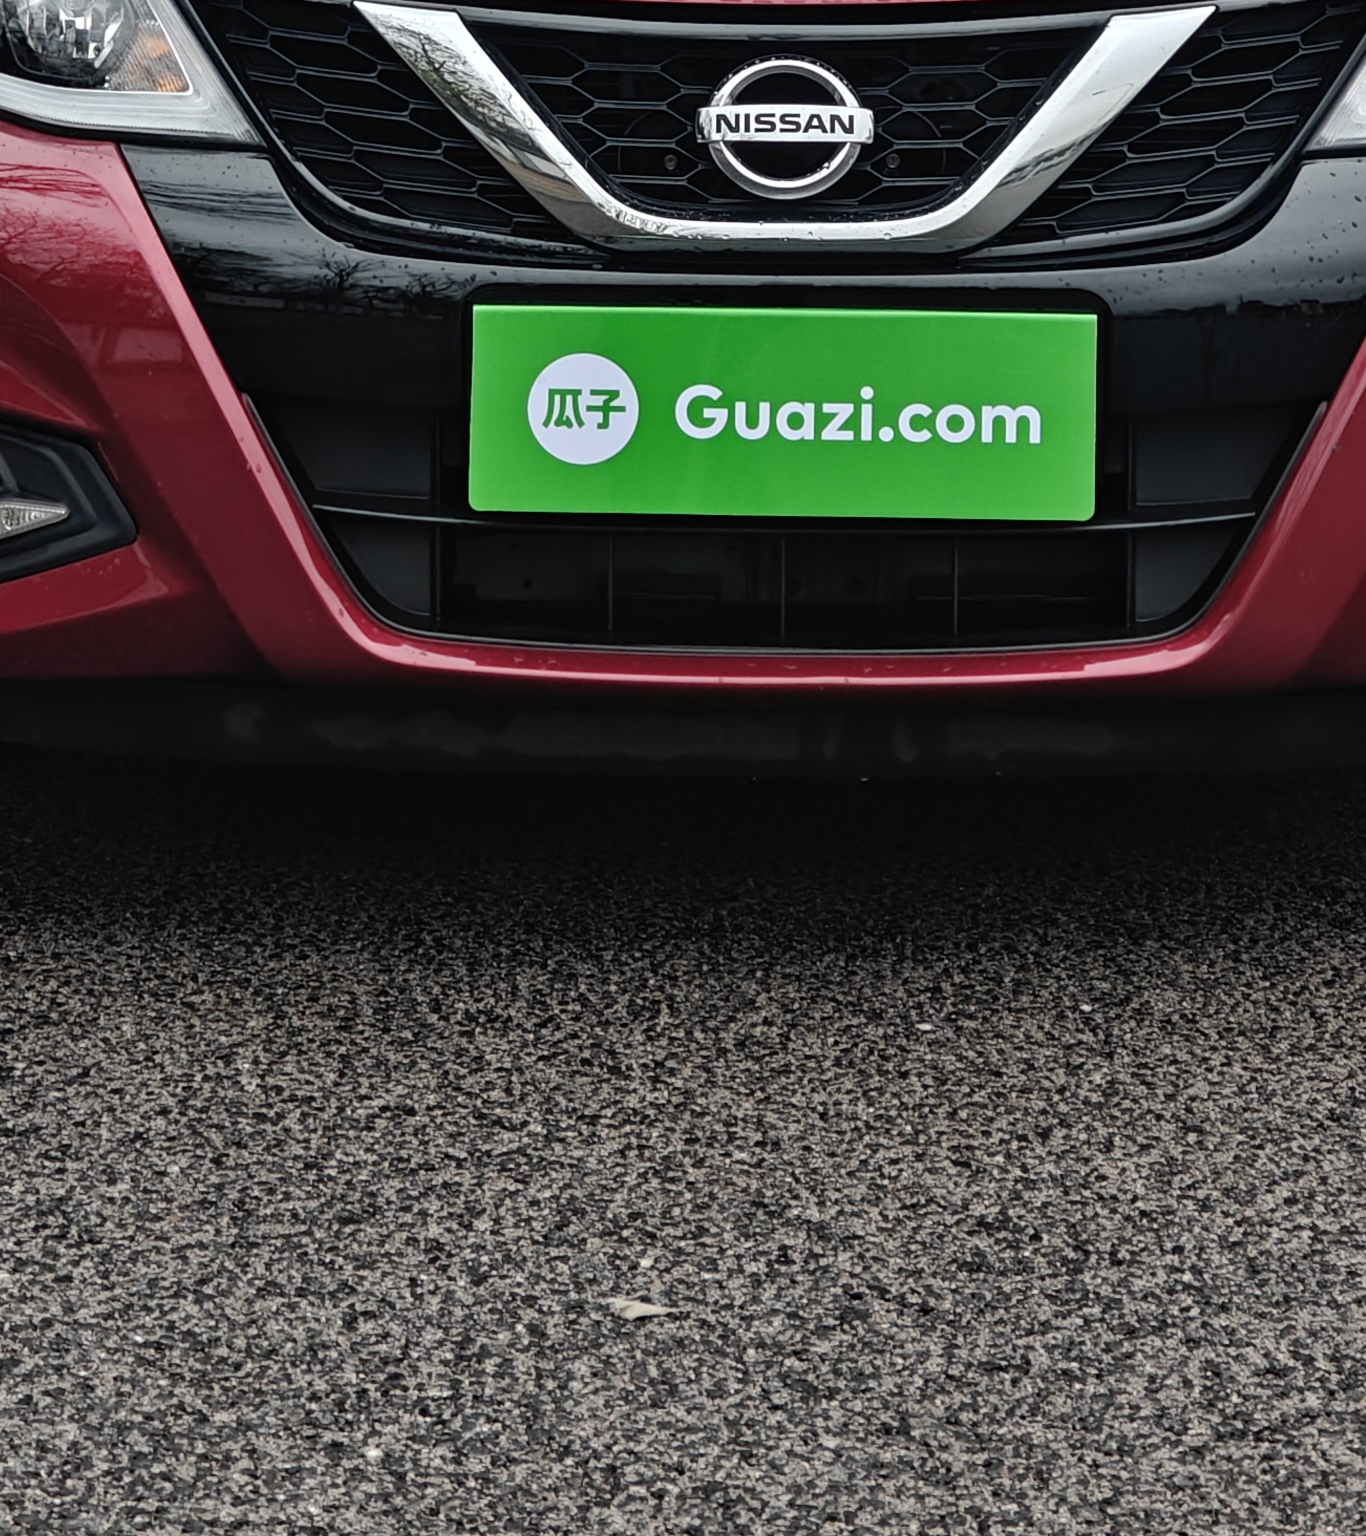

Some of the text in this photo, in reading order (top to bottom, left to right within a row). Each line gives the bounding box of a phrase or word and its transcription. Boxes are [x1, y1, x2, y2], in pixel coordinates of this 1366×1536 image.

[715, 113, 855, 135] NISSAN
[541, 388, 627, 431] 瓜子
[674, 384, 1043, 445] Guazi.com
